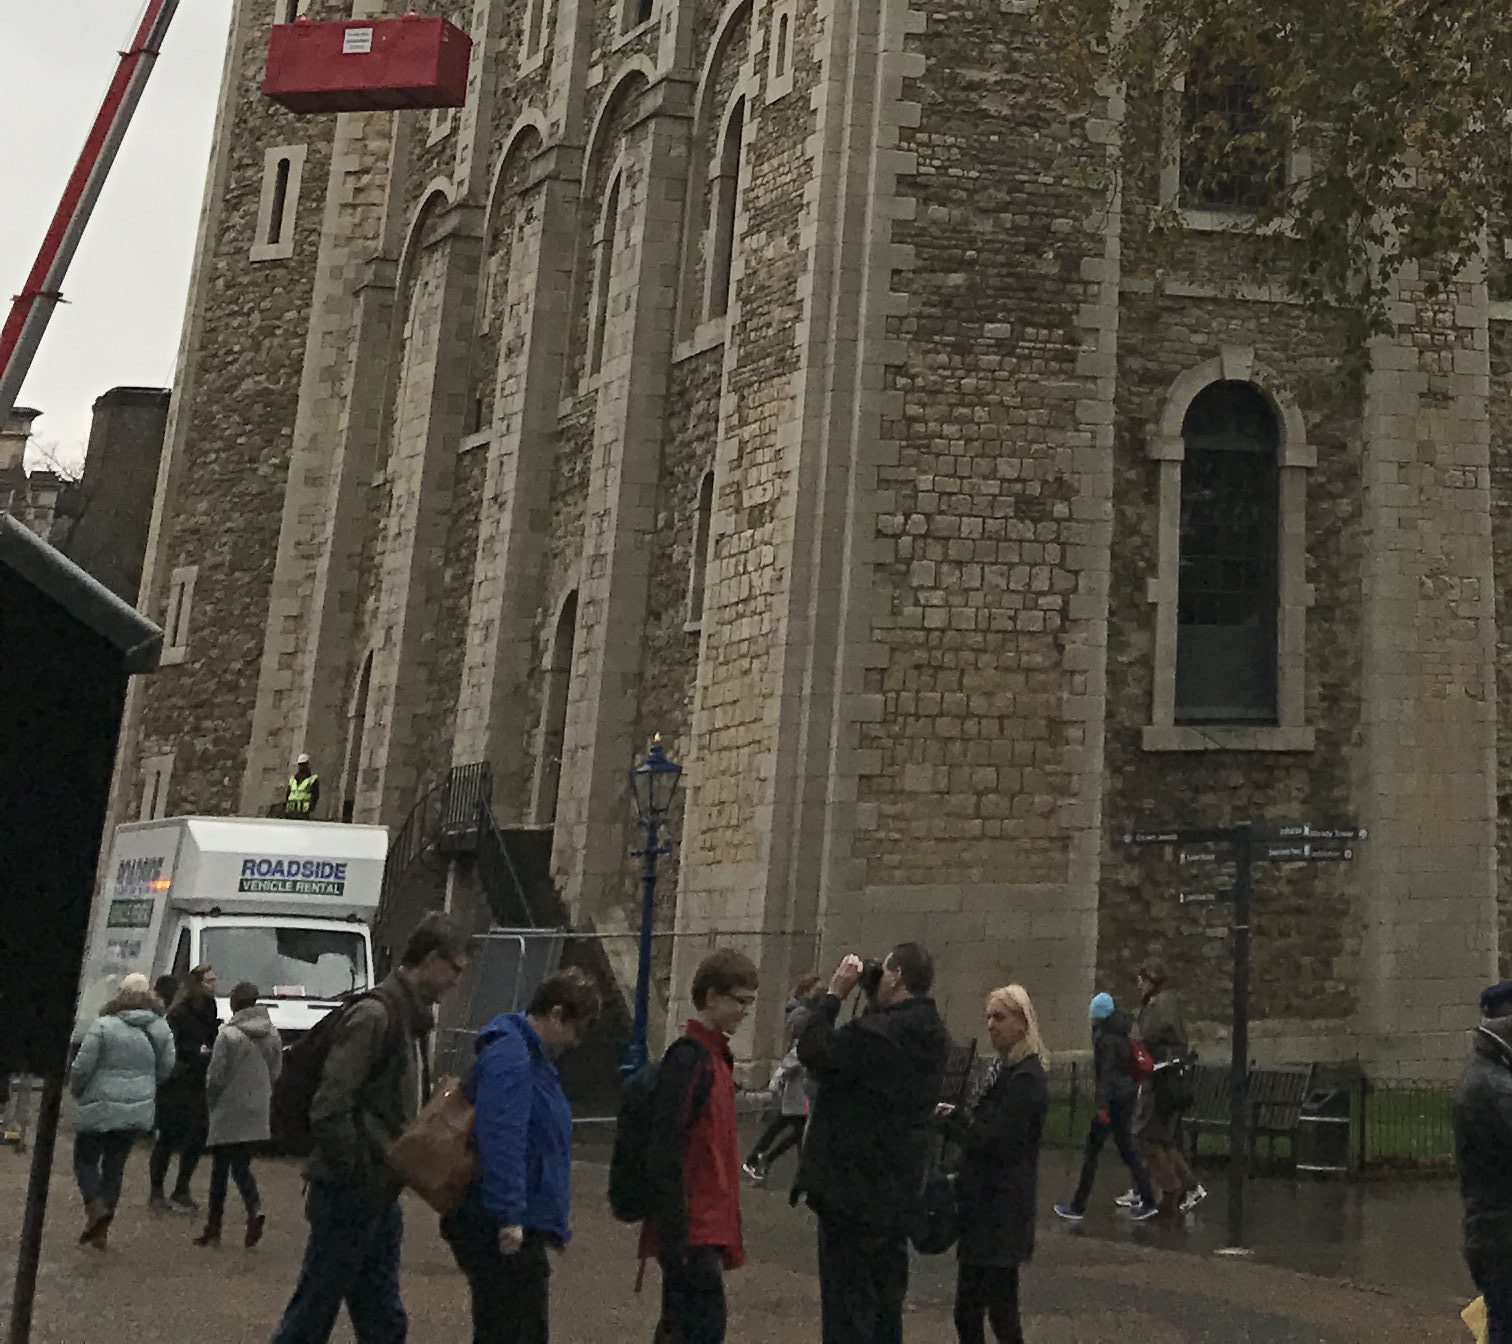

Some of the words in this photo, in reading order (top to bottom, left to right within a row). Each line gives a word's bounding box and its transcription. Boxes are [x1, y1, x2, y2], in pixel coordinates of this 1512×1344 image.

[242, 859, 347, 880] ROADSIDE
[243, 880, 292, 892] VEHICLE
[296, 881, 340, 894] RENTAL
